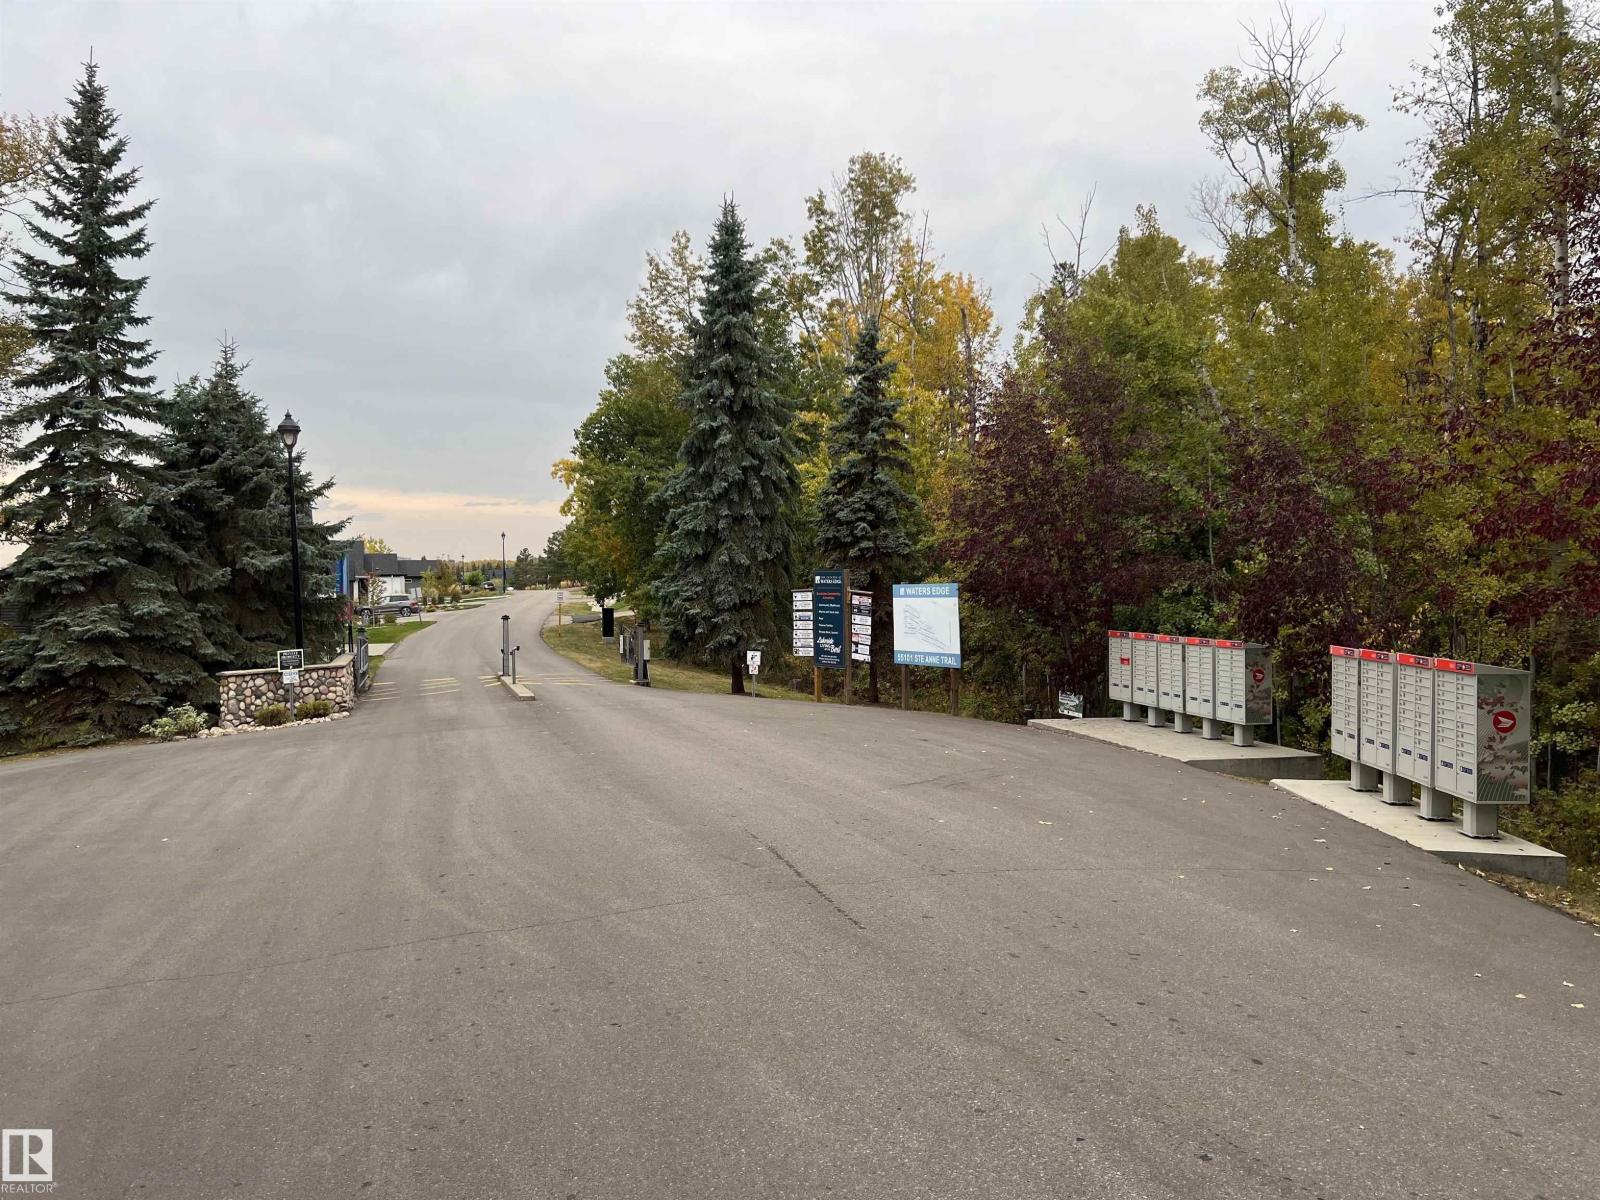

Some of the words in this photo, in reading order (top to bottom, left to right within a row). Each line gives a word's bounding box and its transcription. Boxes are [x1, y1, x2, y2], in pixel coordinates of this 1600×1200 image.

[905, 587, 931, 596] WATERS
[932, 586, 950, 595] EDGE
[897, 653, 913, 662] 55101
[914, 654, 925, 663] STE
[925, 655, 940, 665] ANNE
[940, 656, 958, 666] TRAIL
